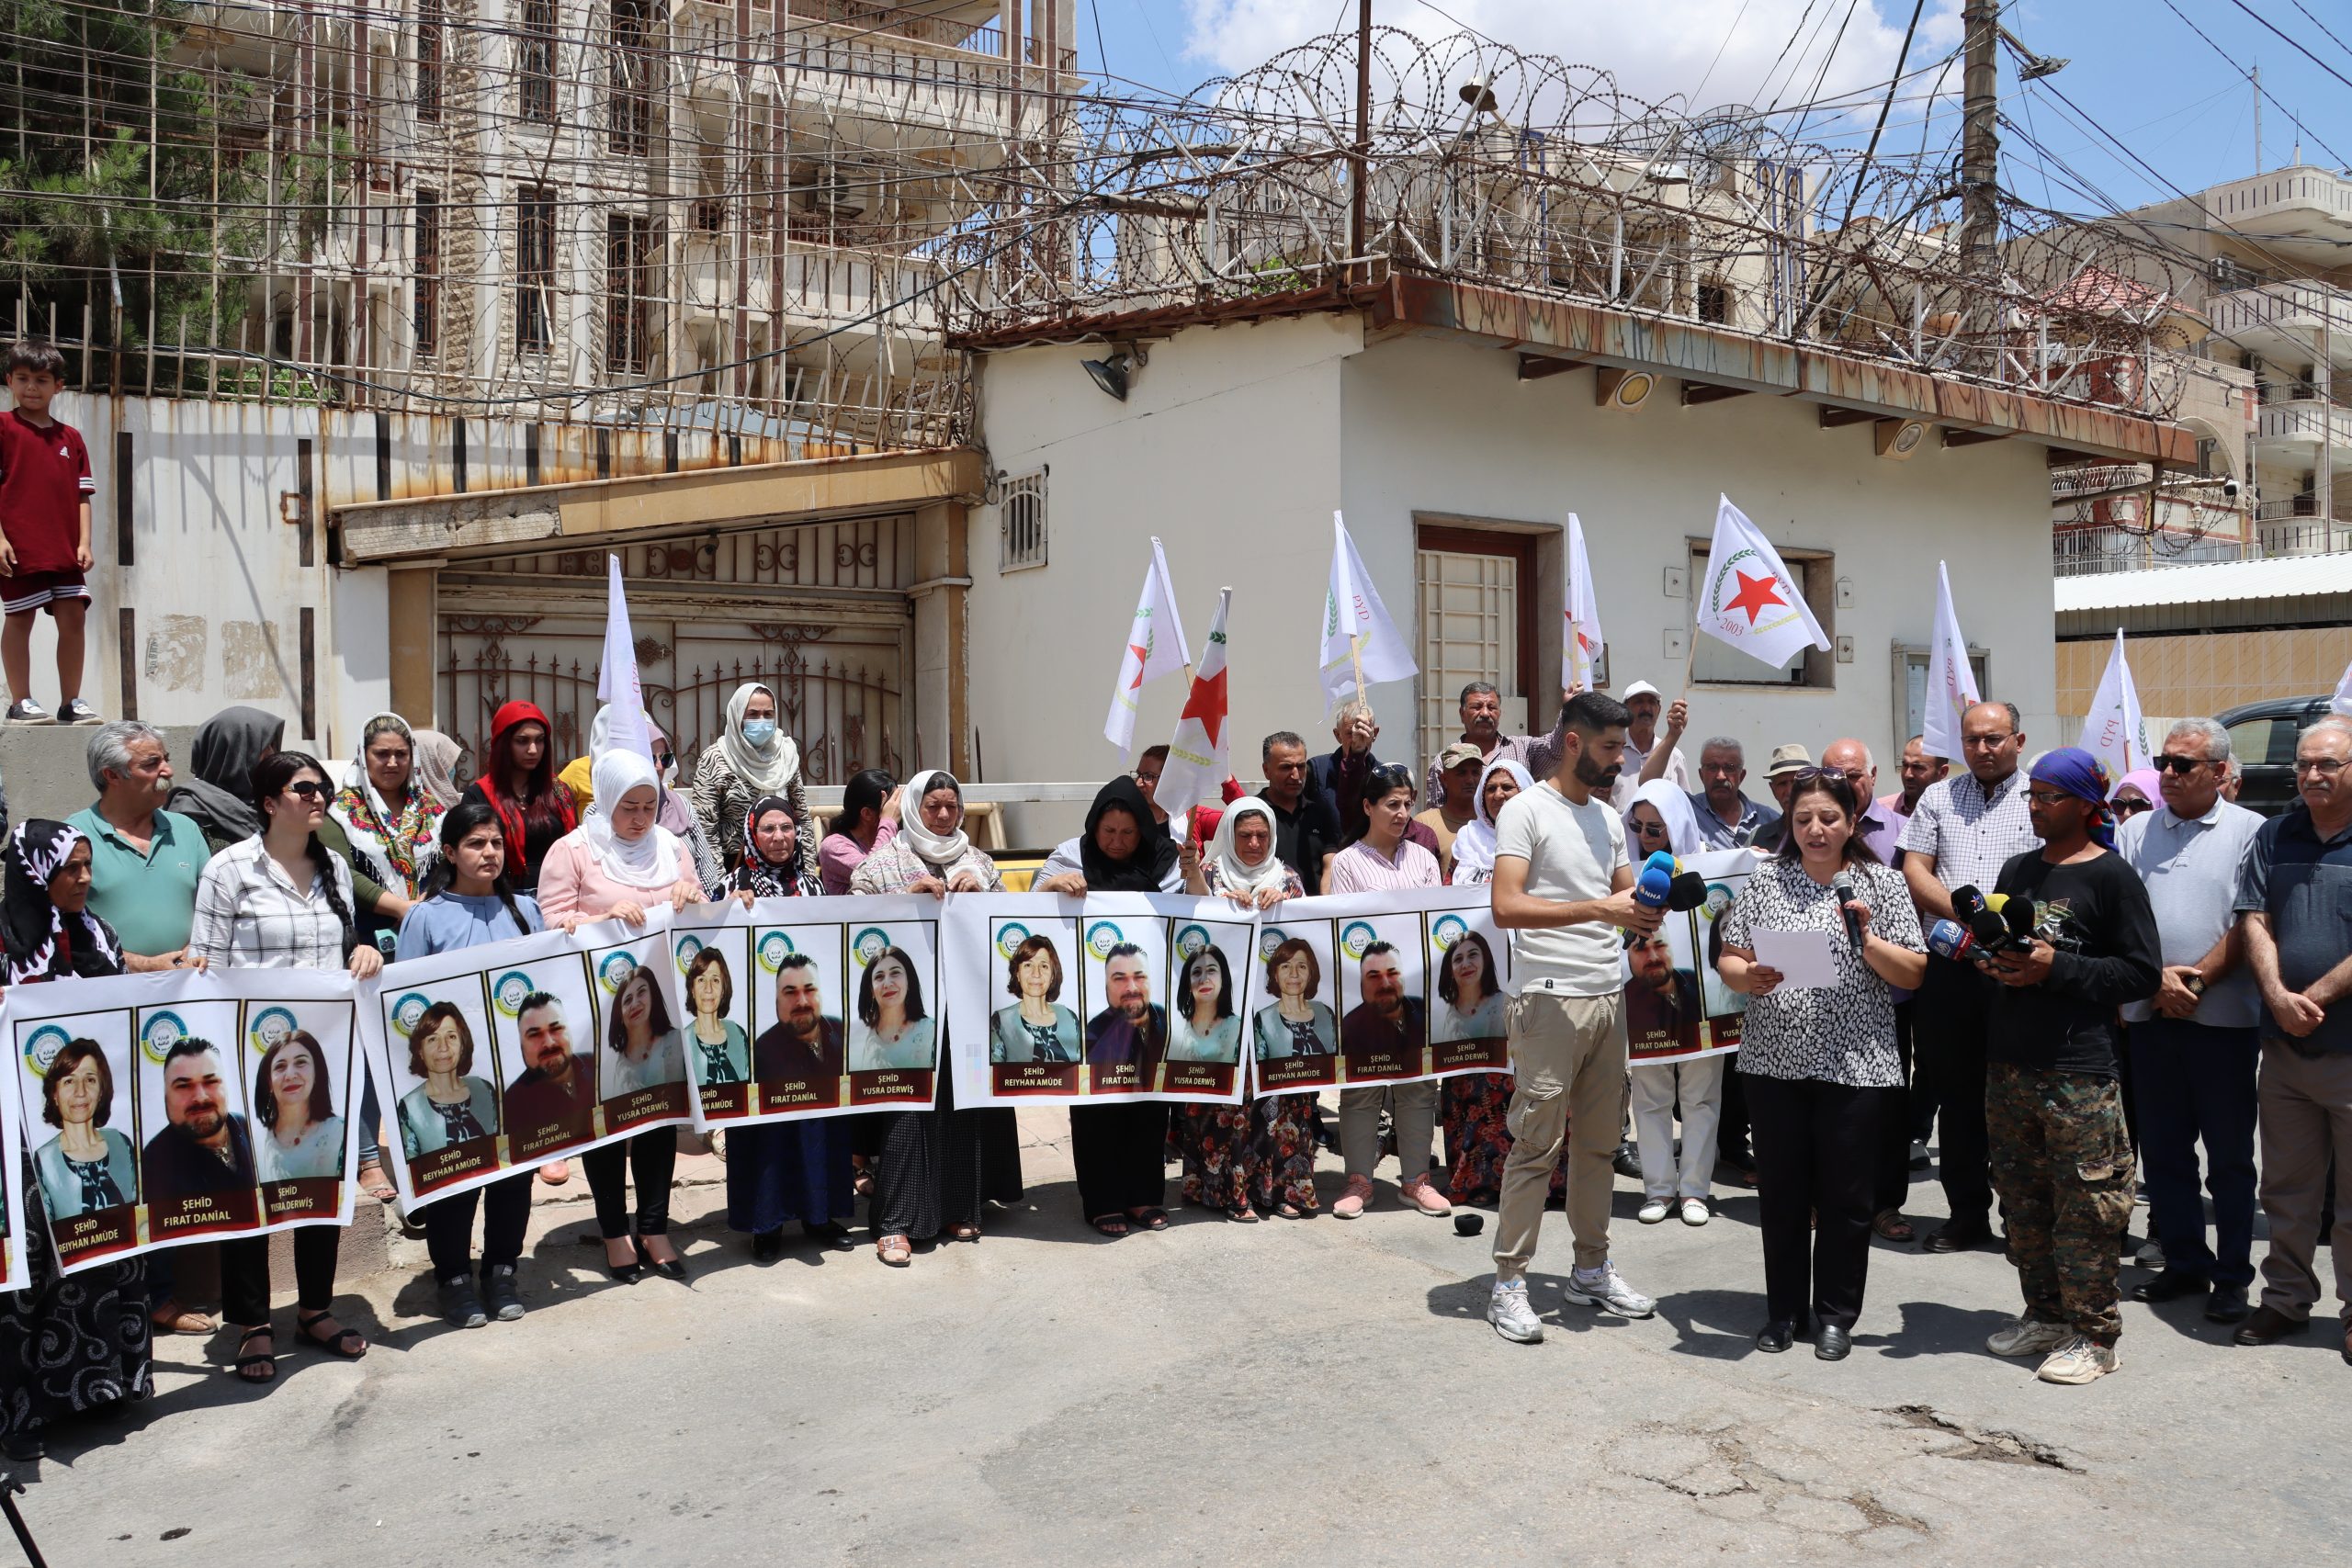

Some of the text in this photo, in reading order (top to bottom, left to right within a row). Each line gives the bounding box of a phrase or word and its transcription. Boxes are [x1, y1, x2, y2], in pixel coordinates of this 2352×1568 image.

[1352, 594, 1370, 620] PYD
[1720, 617, 1744, 637] 2003
[1635, 1042, 1652, 1050] FIRAT
[1443, 1055, 1464, 1064] YUSRA
[1174, 1077, 1193, 1085] YUSRA
[1268, 1072, 1295, 1081] REIYHAN
[1005, 1078, 1035, 1087] REIYHAN
[862, 1087, 886, 1096] YUSRA
[771, 1095, 792, 1104] FIRAT
[617, 1110, 641, 1122] YUSRA
[523, 1141, 544, 1152] FIRAT
[423, 1167, 454, 1182] REIYHAN
[270, 1202, 287, 1213] YUSRA
[164, 1214, 191, 1227] FIRAT
[59, 1236, 92, 1254] REIYHAN
